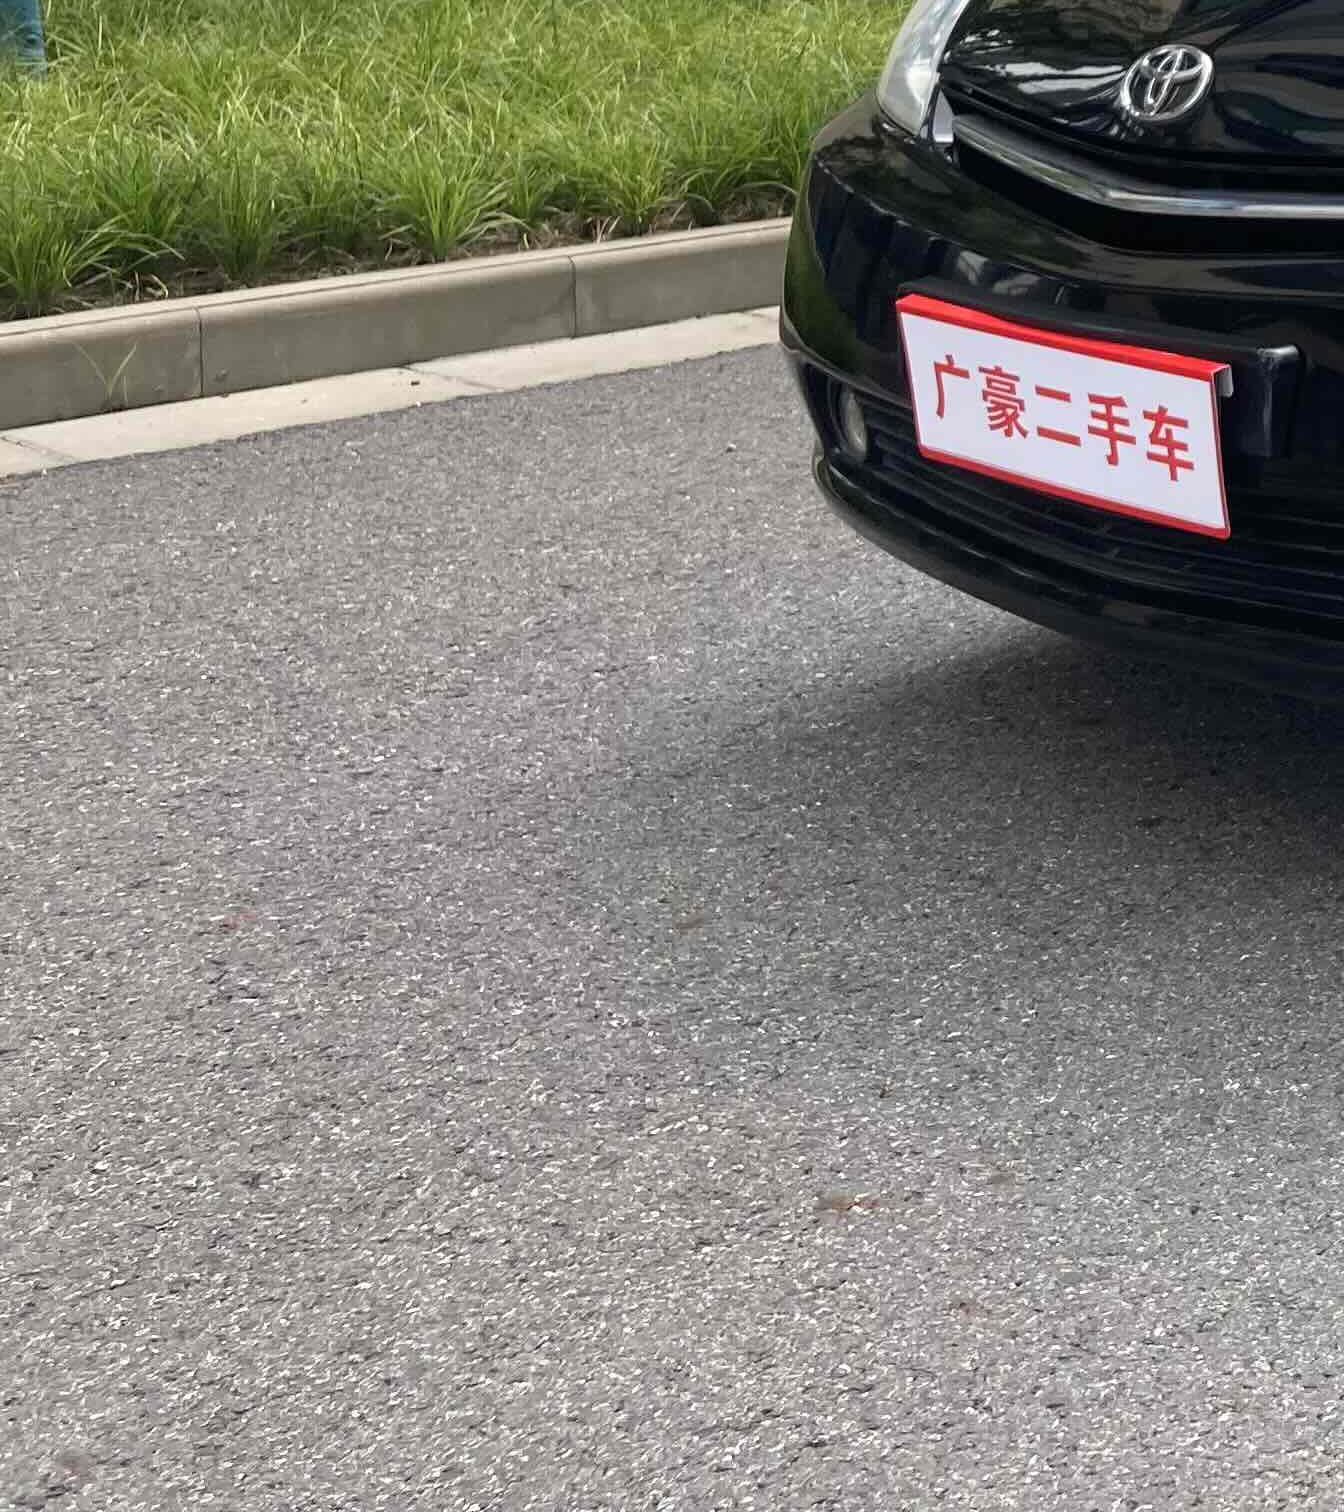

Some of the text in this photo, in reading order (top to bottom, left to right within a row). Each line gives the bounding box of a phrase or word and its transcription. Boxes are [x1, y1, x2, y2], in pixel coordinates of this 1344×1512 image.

[933, 354, 1195, 482] 广豪二手车
